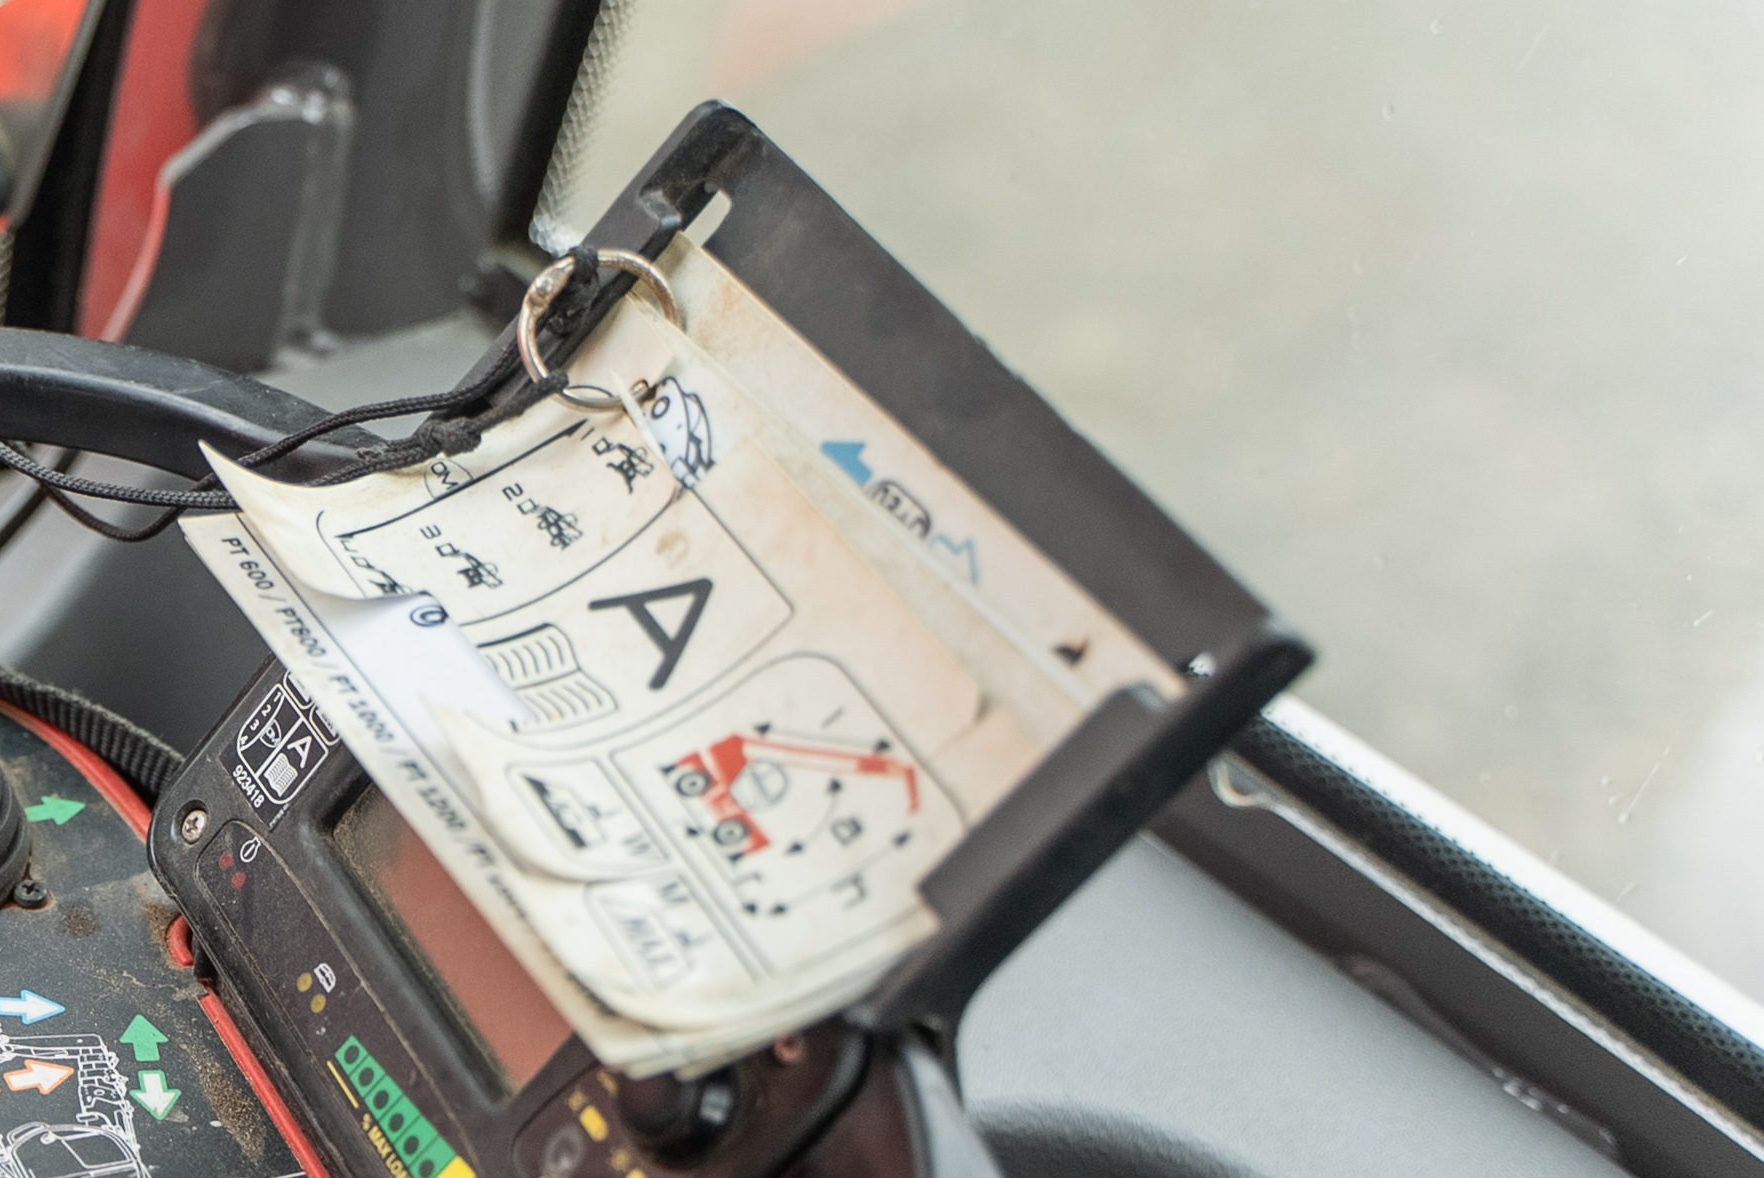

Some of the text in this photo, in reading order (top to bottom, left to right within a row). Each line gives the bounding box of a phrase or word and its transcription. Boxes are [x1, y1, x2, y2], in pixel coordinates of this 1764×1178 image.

[220, 537, 250, 555] PT
[239, 560, 275, 590] 600
[588, 577, 714, 690] A
[249, 718, 260, 731] 3
[261, 704, 272, 717] 2
[287, 735, 313, 769] A
[232, 764, 265, 808] 923418
[367, 1125, 393, 1159] MAX
